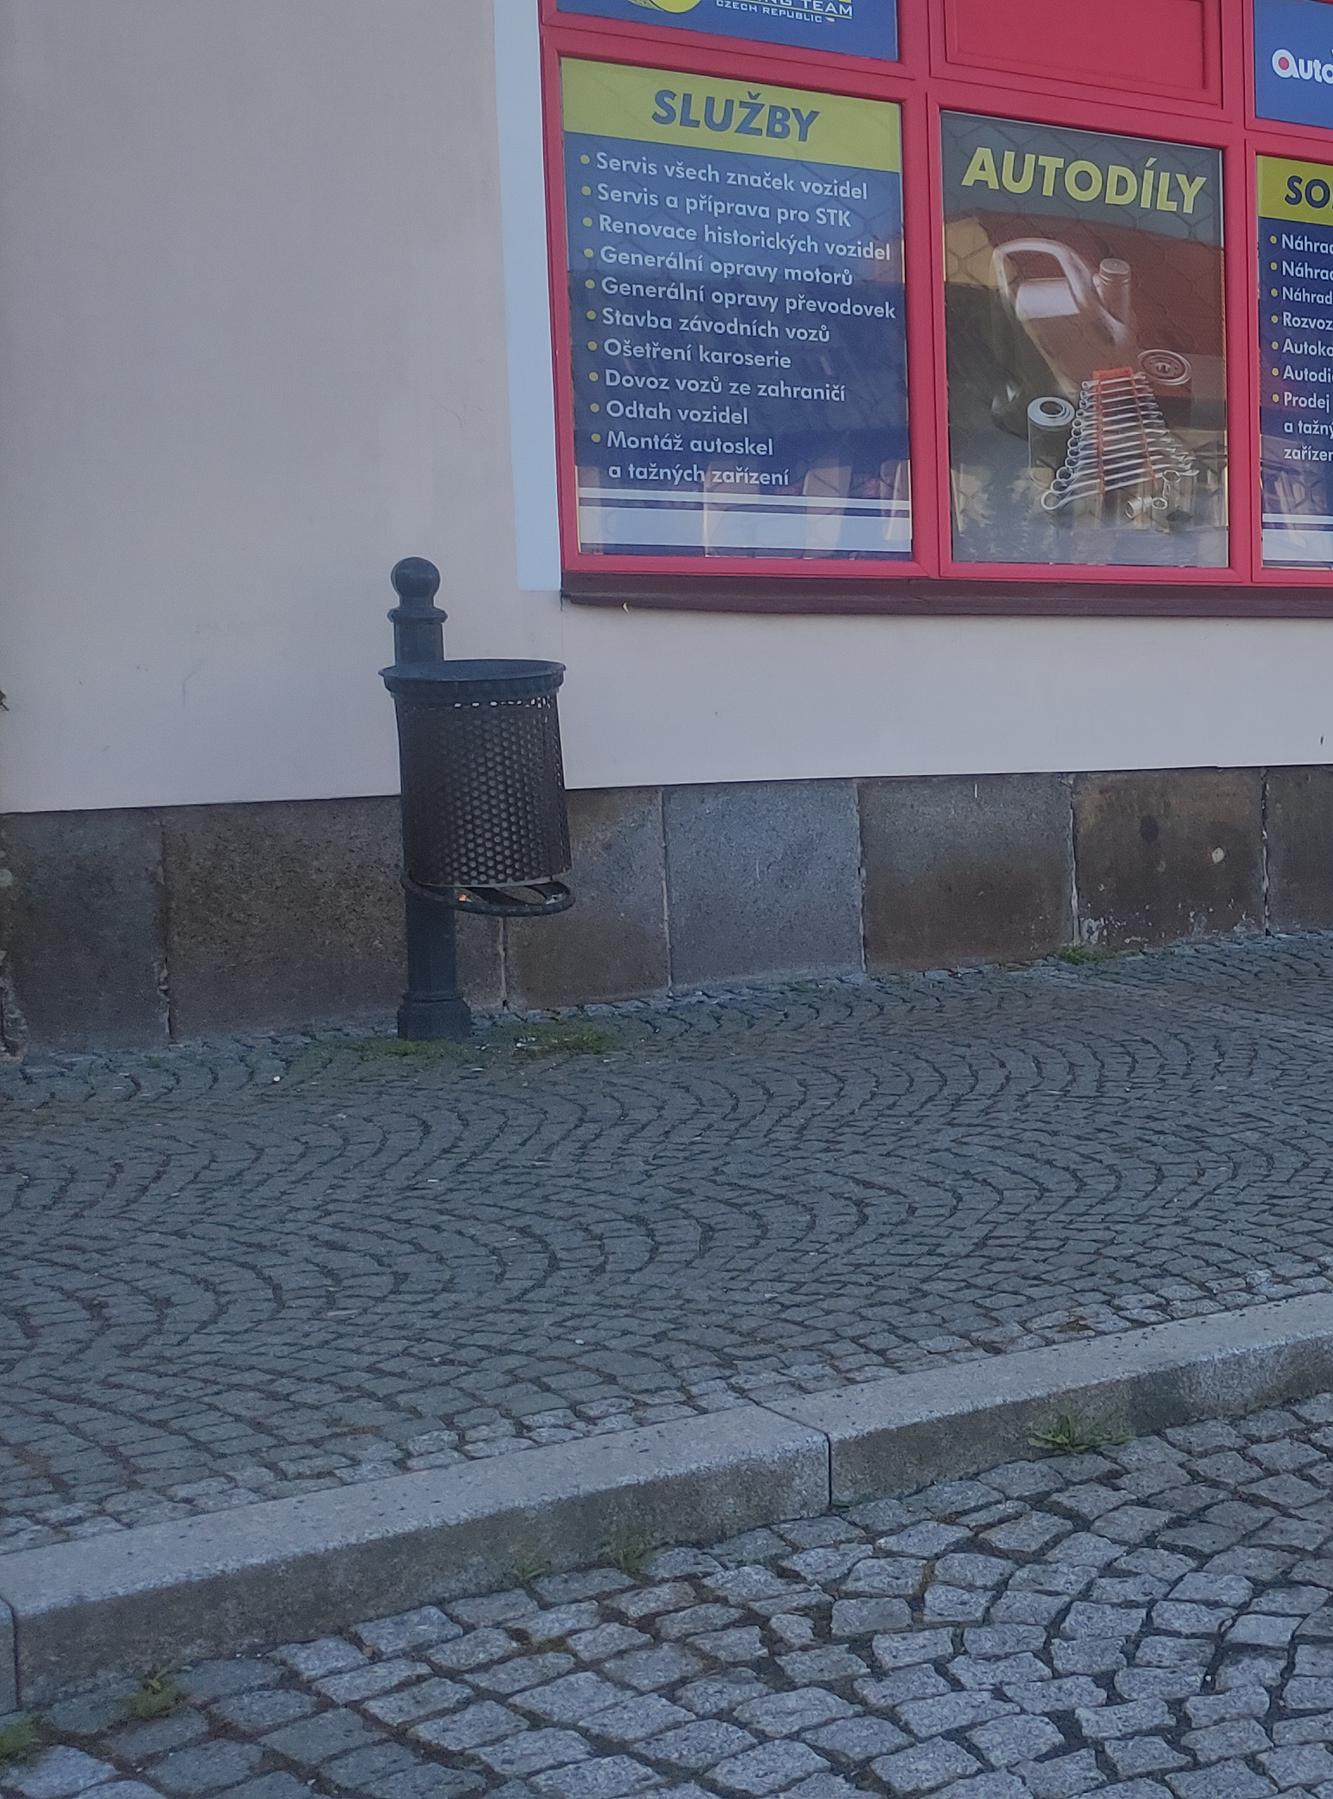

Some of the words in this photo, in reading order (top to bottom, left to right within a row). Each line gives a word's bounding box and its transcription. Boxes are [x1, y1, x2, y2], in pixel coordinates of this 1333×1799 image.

[716, 0, 758, 13] CZECH
[762, 7, 822, 23] REPUBLIC
[799, 0, 853, 17] TEAM
[651, 90, 820, 141] SLUŽBY
[597, 152, 657, 176] Servis
[664, 160, 720, 183] všech
[727, 168, 795, 191] značek
[800, 176, 867, 200] vozidel
[961, 145, 1208, 214] AUTODÍLY
[598, 184, 658, 207] Servis
[666, 196, 678, 209] a
[685, 194, 770, 219] příprava
[777, 207, 808, 225] pro
[816, 209, 851, 227] STK
[600, 215, 697, 241] Renovace
[704, 226, 818, 255] historických
[825, 236, 890, 261] vozidel
[601, 246, 702, 271] Generální
[711, 258, 778, 283] opravy
[784, 264, 853, 286] motorů
[602, 277, 704, 302] Generální
[711, 290, 779, 312] opravy
[786, 294, 896, 319] převodovek
[602, 308, 672, 329] Stavba
[679, 315, 778, 338] závodních
[785, 325, 830, 342] vozů
[1283, 312, 1333, 330] Rozvoz
[603, 337, 691, 362] Ošetření
[700, 346, 791, 369] karoserie
[605, 369, 669, 390] Dovoz
[676, 372, 722, 392] vozů
[729, 382, 751, 395] ze
[757, 380, 845, 401] zahraničí
[606, 399, 671, 420] Odtah
[678, 405, 748, 425] vozidel
[1284, 392, 1330, 413] Prodej
[608, 430, 683, 451] Montáž
[690, 436, 773, 456] autoskel
[1284, 422, 1293, 432] a
[608, 465, 621, 478] a
[628, 462, 705, 484] tažných
[712, 468, 789, 486] zařízení
